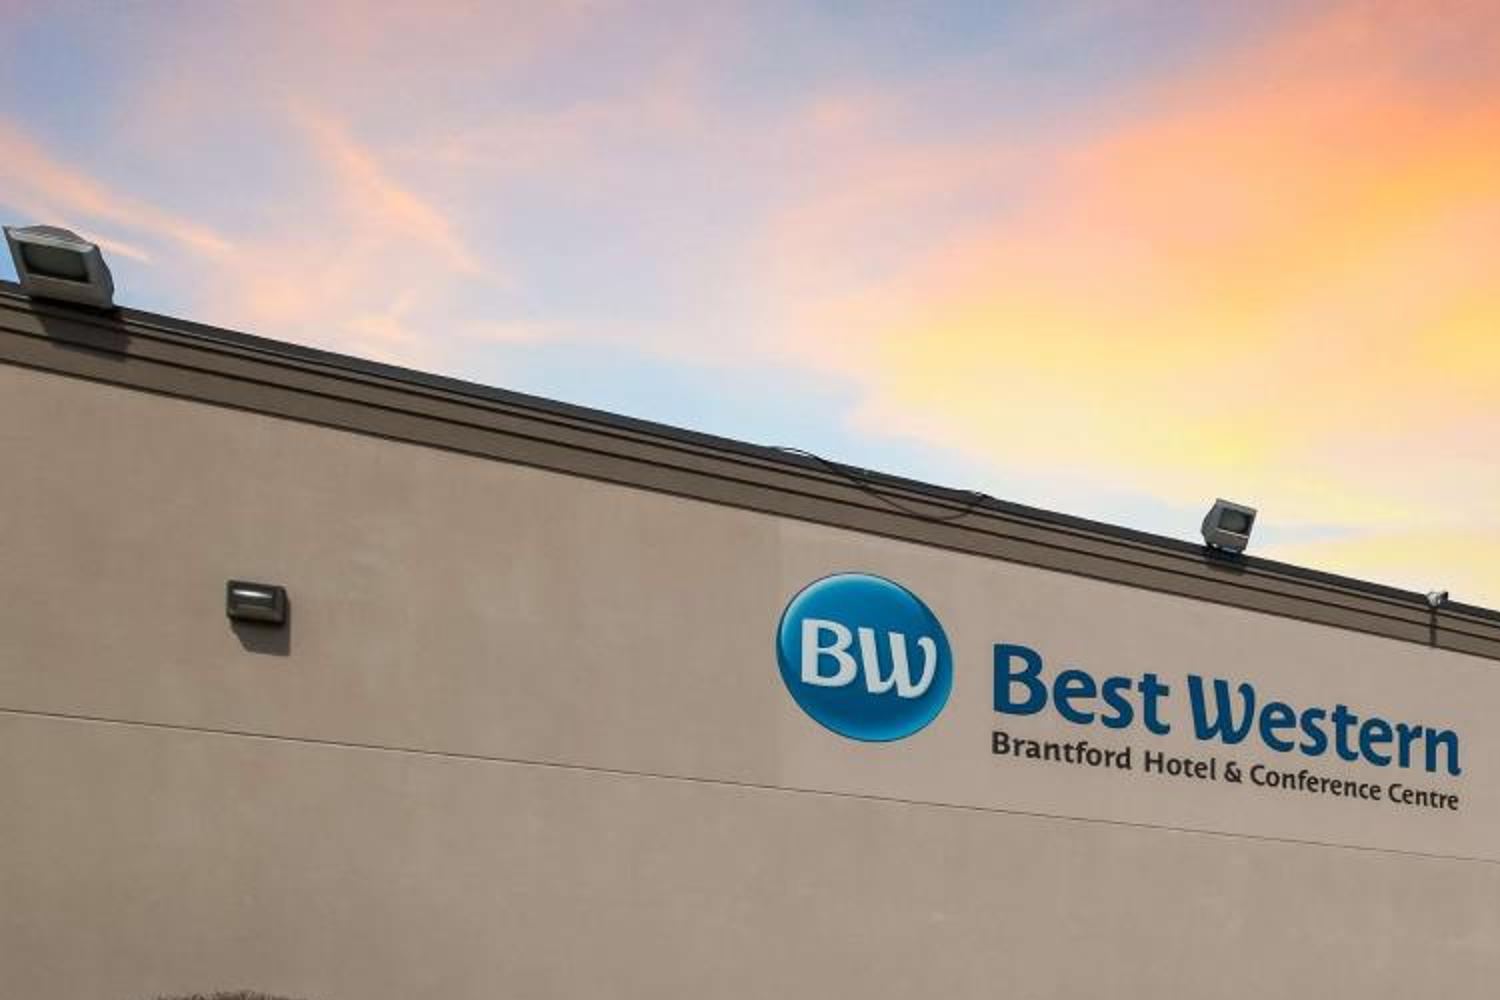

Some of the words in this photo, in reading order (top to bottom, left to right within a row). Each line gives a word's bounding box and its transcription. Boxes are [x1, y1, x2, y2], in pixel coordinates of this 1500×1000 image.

[801, 619, 937, 699] BW
[992, 643, 1171, 736] Best
[1186, 674, 1462, 777] Western
[991, 730, 1132, 771] Brantford
[1144, 749, 1217, 781] Hotel
[1223, 761, 1243, 785] &
[1249, 765, 1382, 801] Conference
[1387, 783, 1460, 811] Centre
